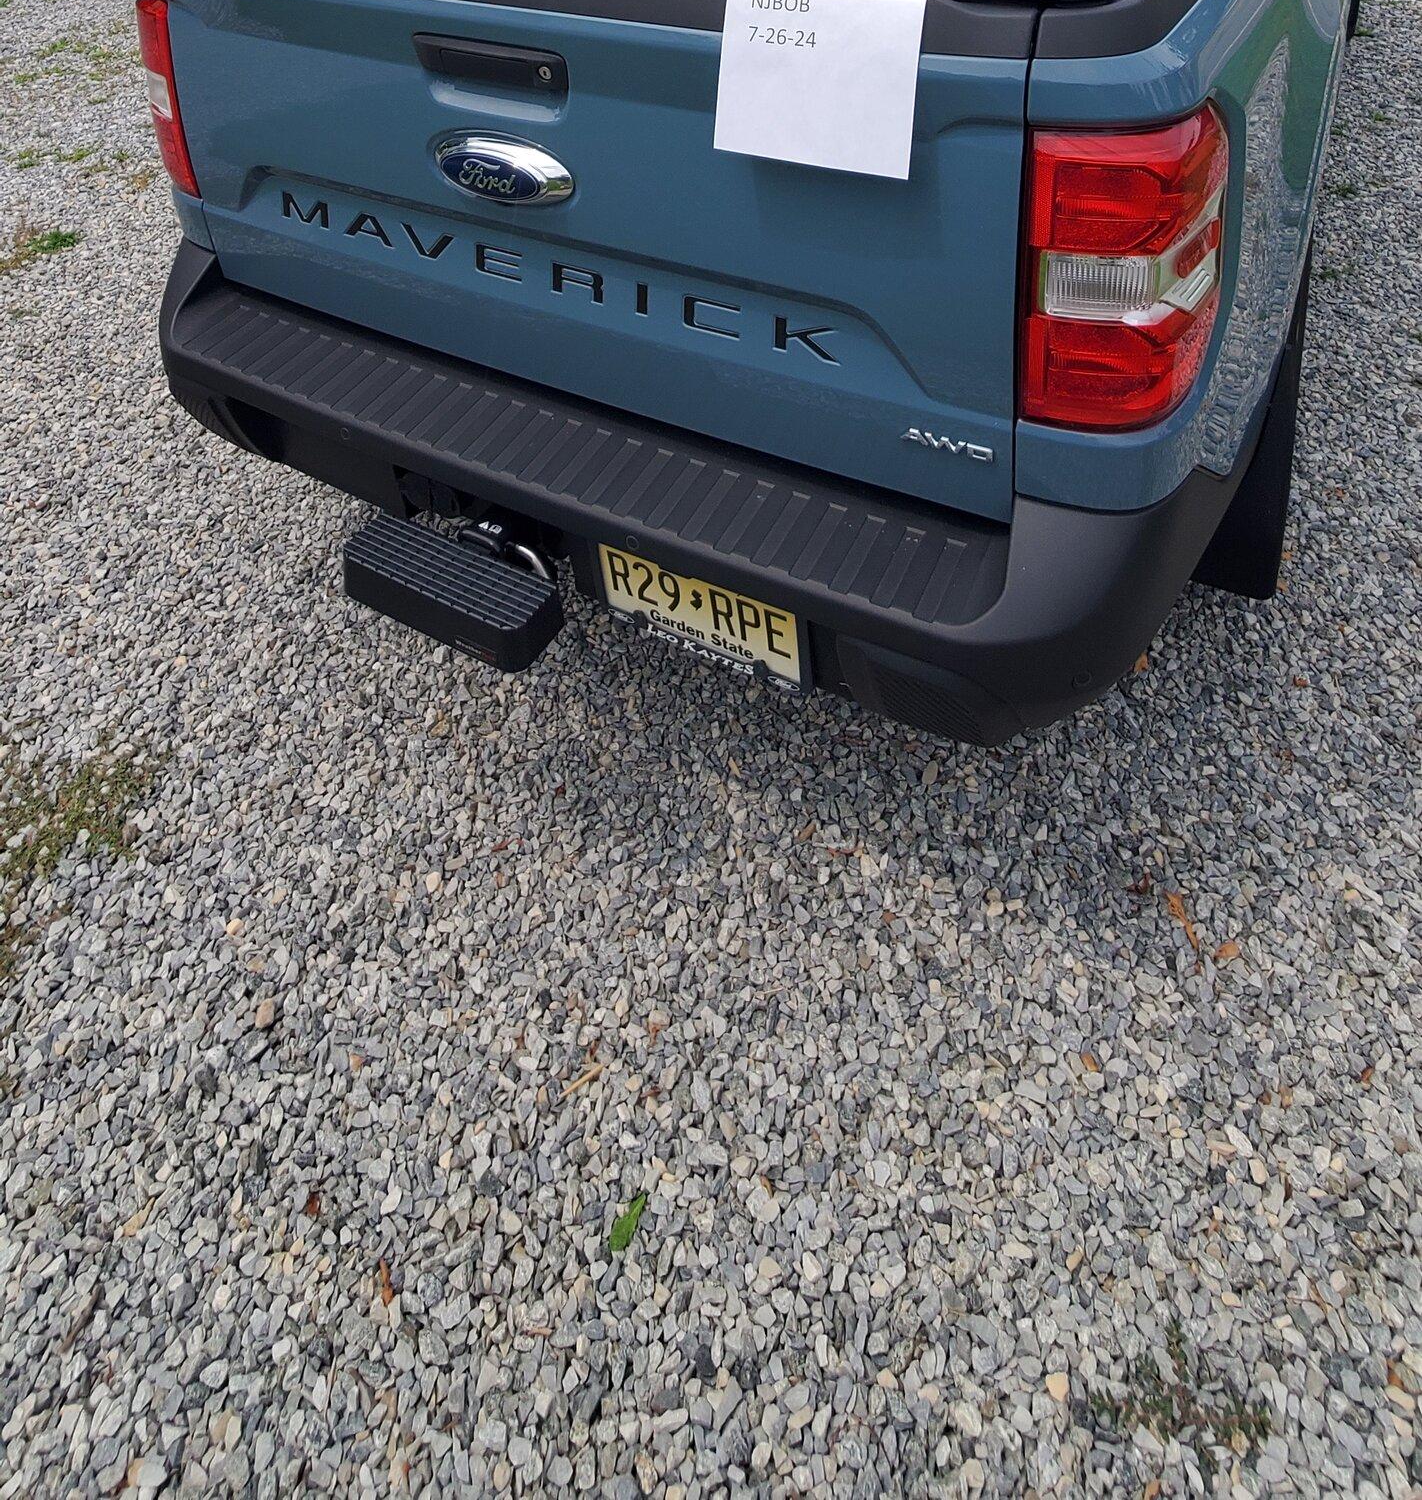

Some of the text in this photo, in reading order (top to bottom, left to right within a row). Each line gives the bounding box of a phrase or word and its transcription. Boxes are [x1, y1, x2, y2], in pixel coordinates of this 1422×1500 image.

[748, 25, 817, 49] 7-26-24
[458, 157, 517, 195] Ford
[280, 190, 842, 367] MAVERICK
[900, 427, 994, 463] AWD
[606, 549, 792, 660] R29 RPE
[646, 623, 679, 644] LEO
[649, 608, 754, 660] Garden State
